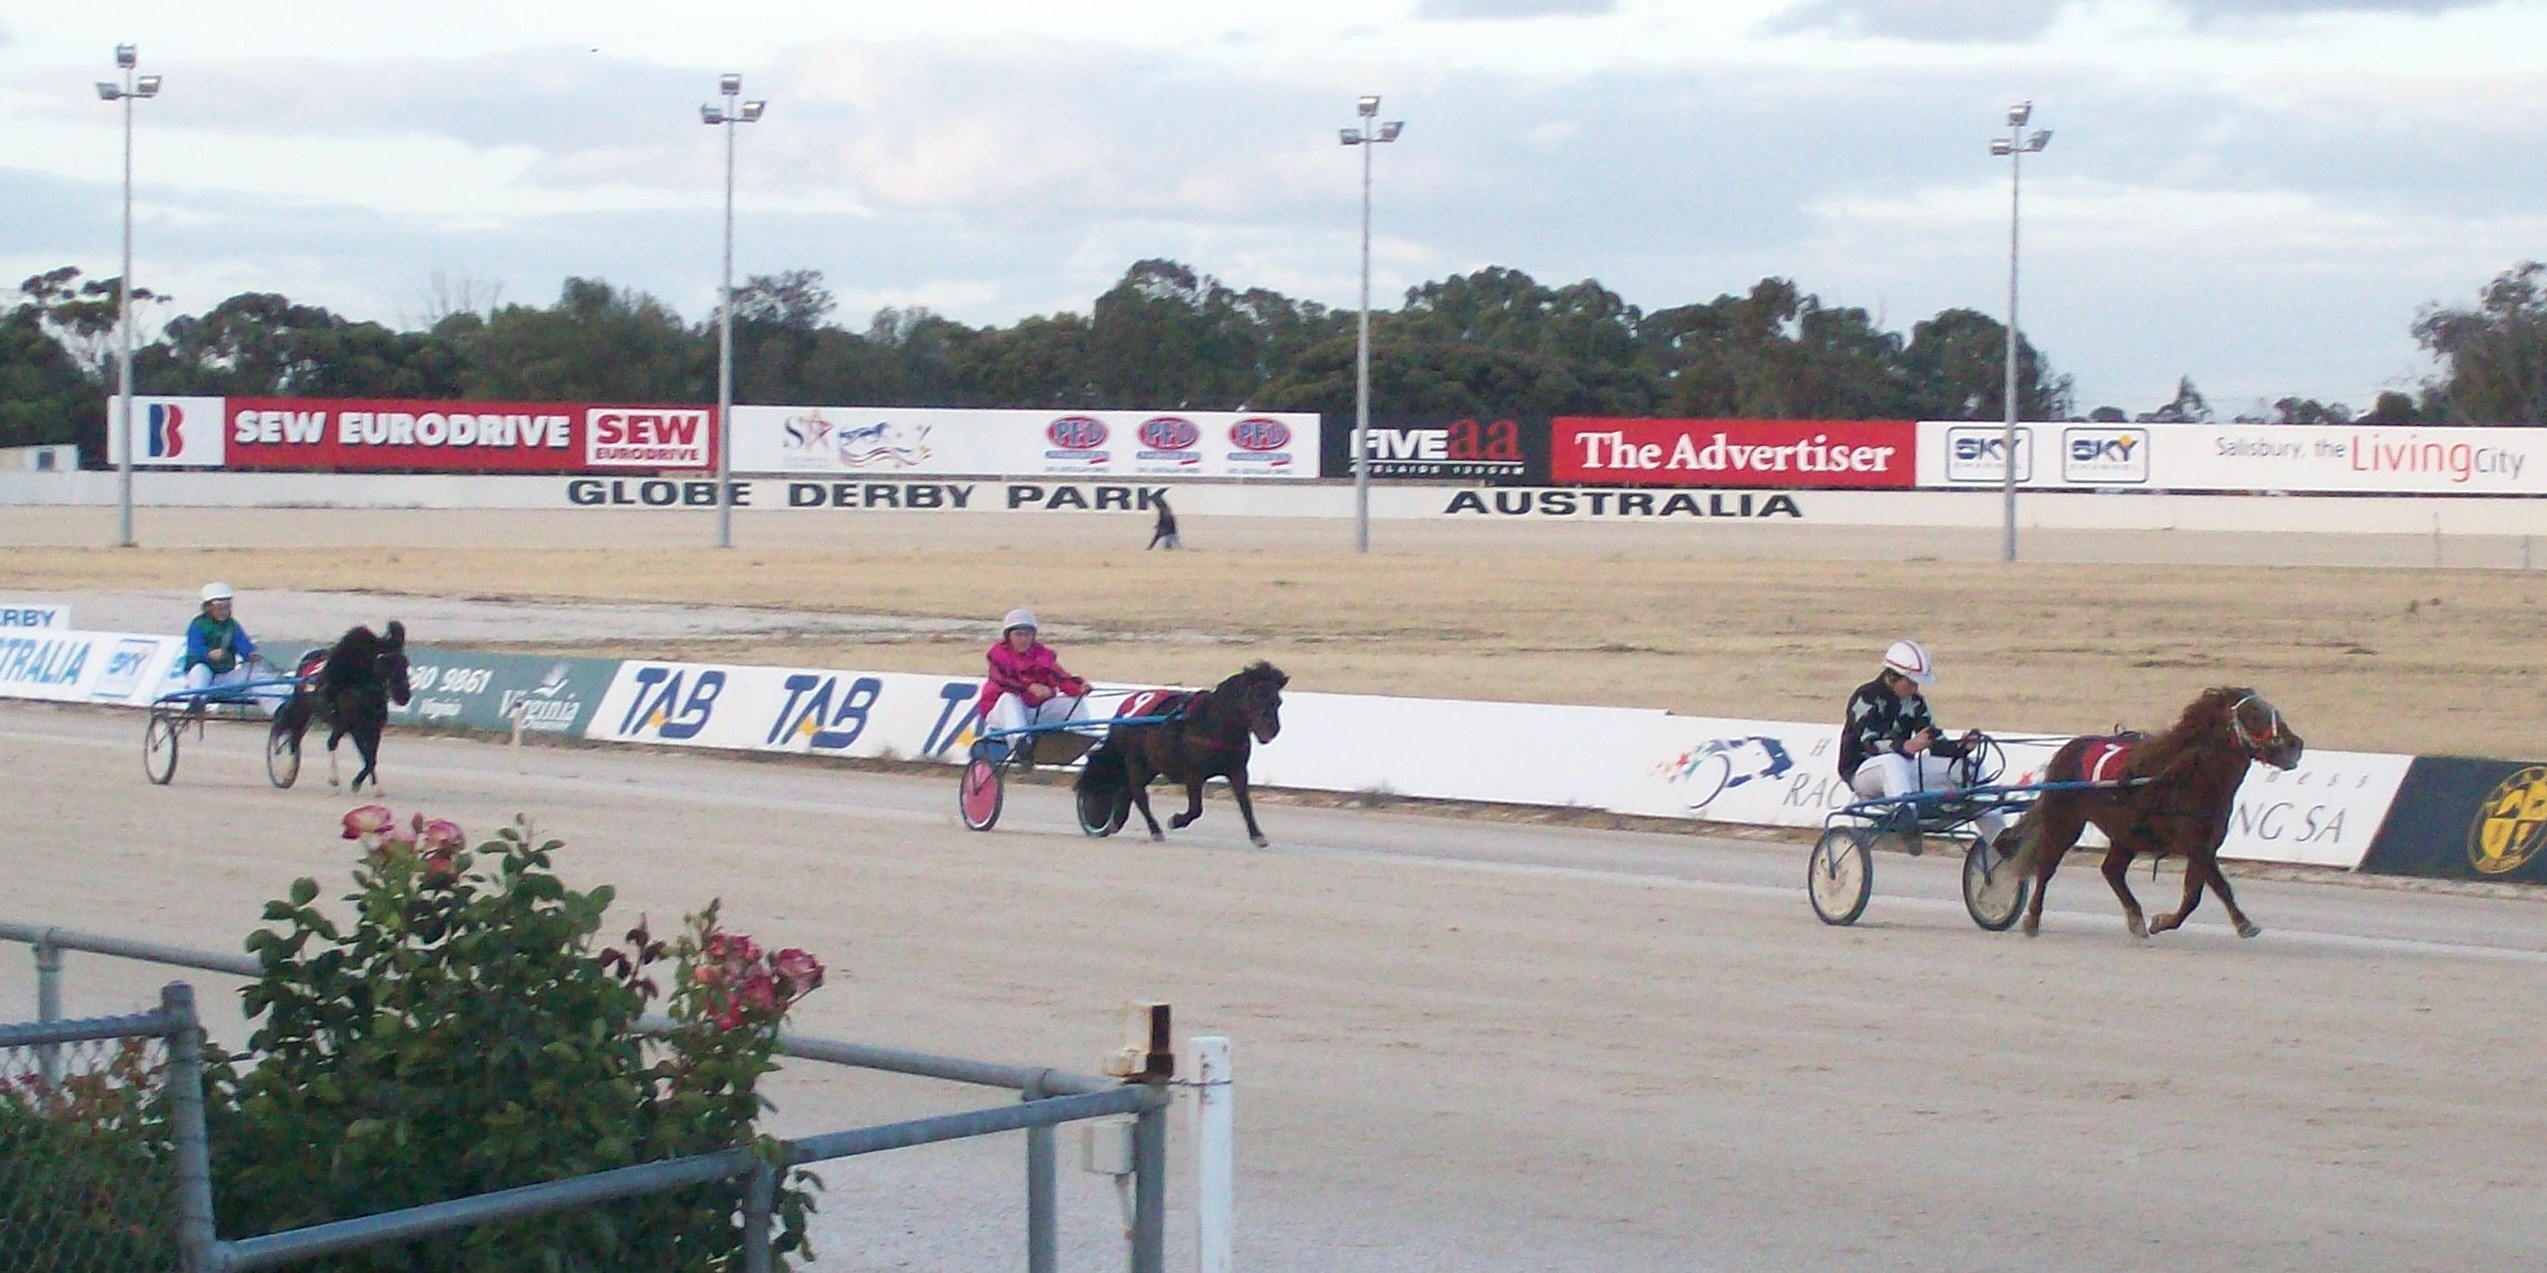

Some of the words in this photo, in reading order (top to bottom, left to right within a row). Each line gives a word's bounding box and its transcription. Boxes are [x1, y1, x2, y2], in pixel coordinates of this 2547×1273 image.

[234, 410, 327, 443] SEW
[338, 412, 570, 447] EURODRIVE
[597, 414, 700, 445] SEW
[1056, 421, 1100, 444] PFD
[1148, 423, 1196, 446] PFD
[1238, 424, 1286, 446] PFD
[596, 448, 698, 461] EURODRIVE
[1574, 431, 1662, 470] The
[1664, 433, 1896, 472] Advertiser
[1955, 437, 2023, 461] SKY
[2072, 434, 2140, 462] SKY
[2314, 438, 2347, 459] the
[2352, 433, 2472, 483] Living
[2475, 447, 2525, 479] City
[568, 479, 753, 506] GLOBE
[788, 482, 977, 508] DERBY
[1008, 484, 1170, 510] PARK
[1443, 490, 1803, 518] AUSTRALIA
[0, 608, 56, 628] RBY
[0, 638, 92, 685] TRALIA
[619, 667, 726, 740] TAB
[767, 674, 883, 749] TAB
[922, 682, 989, 756] TA
[1122, 692, 1156, 719] 9
[1782, 772, 1848, 809] RAC
[2264, 770, 2369, 790] ness
[2230, 801, 2293, 841] NG
[2295, 805, 2347, 844] SA
